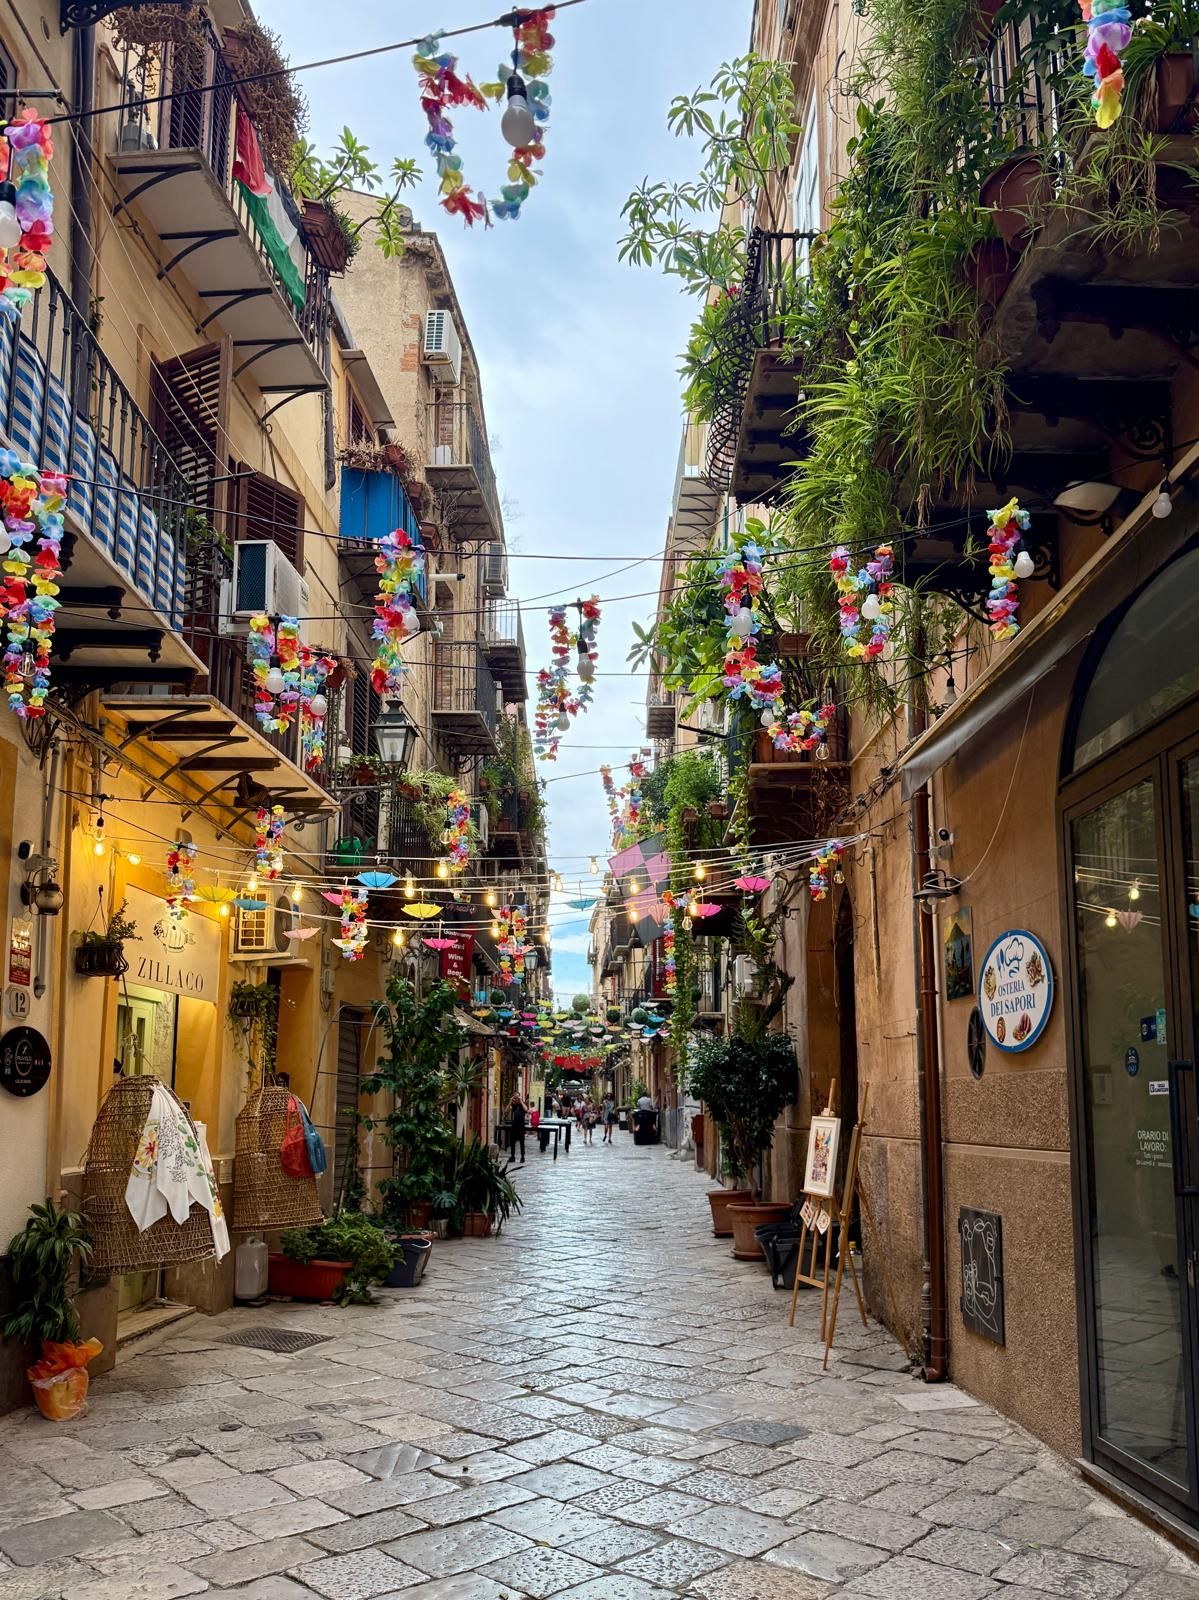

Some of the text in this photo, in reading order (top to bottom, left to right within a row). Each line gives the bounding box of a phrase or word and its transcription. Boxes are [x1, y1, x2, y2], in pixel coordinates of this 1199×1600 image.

[138, 957, 204, 993] ZILLACO
[998, 980, 1025, 997] OSTERIA
[15, 992, 26, 1013] 12
[991, 993, 1036, 1017] DEI SAPORI
[1137, 1130, 1169, 1141] ORARIO DI
[1139, 1140, 1167, 1152] LAVORO:
